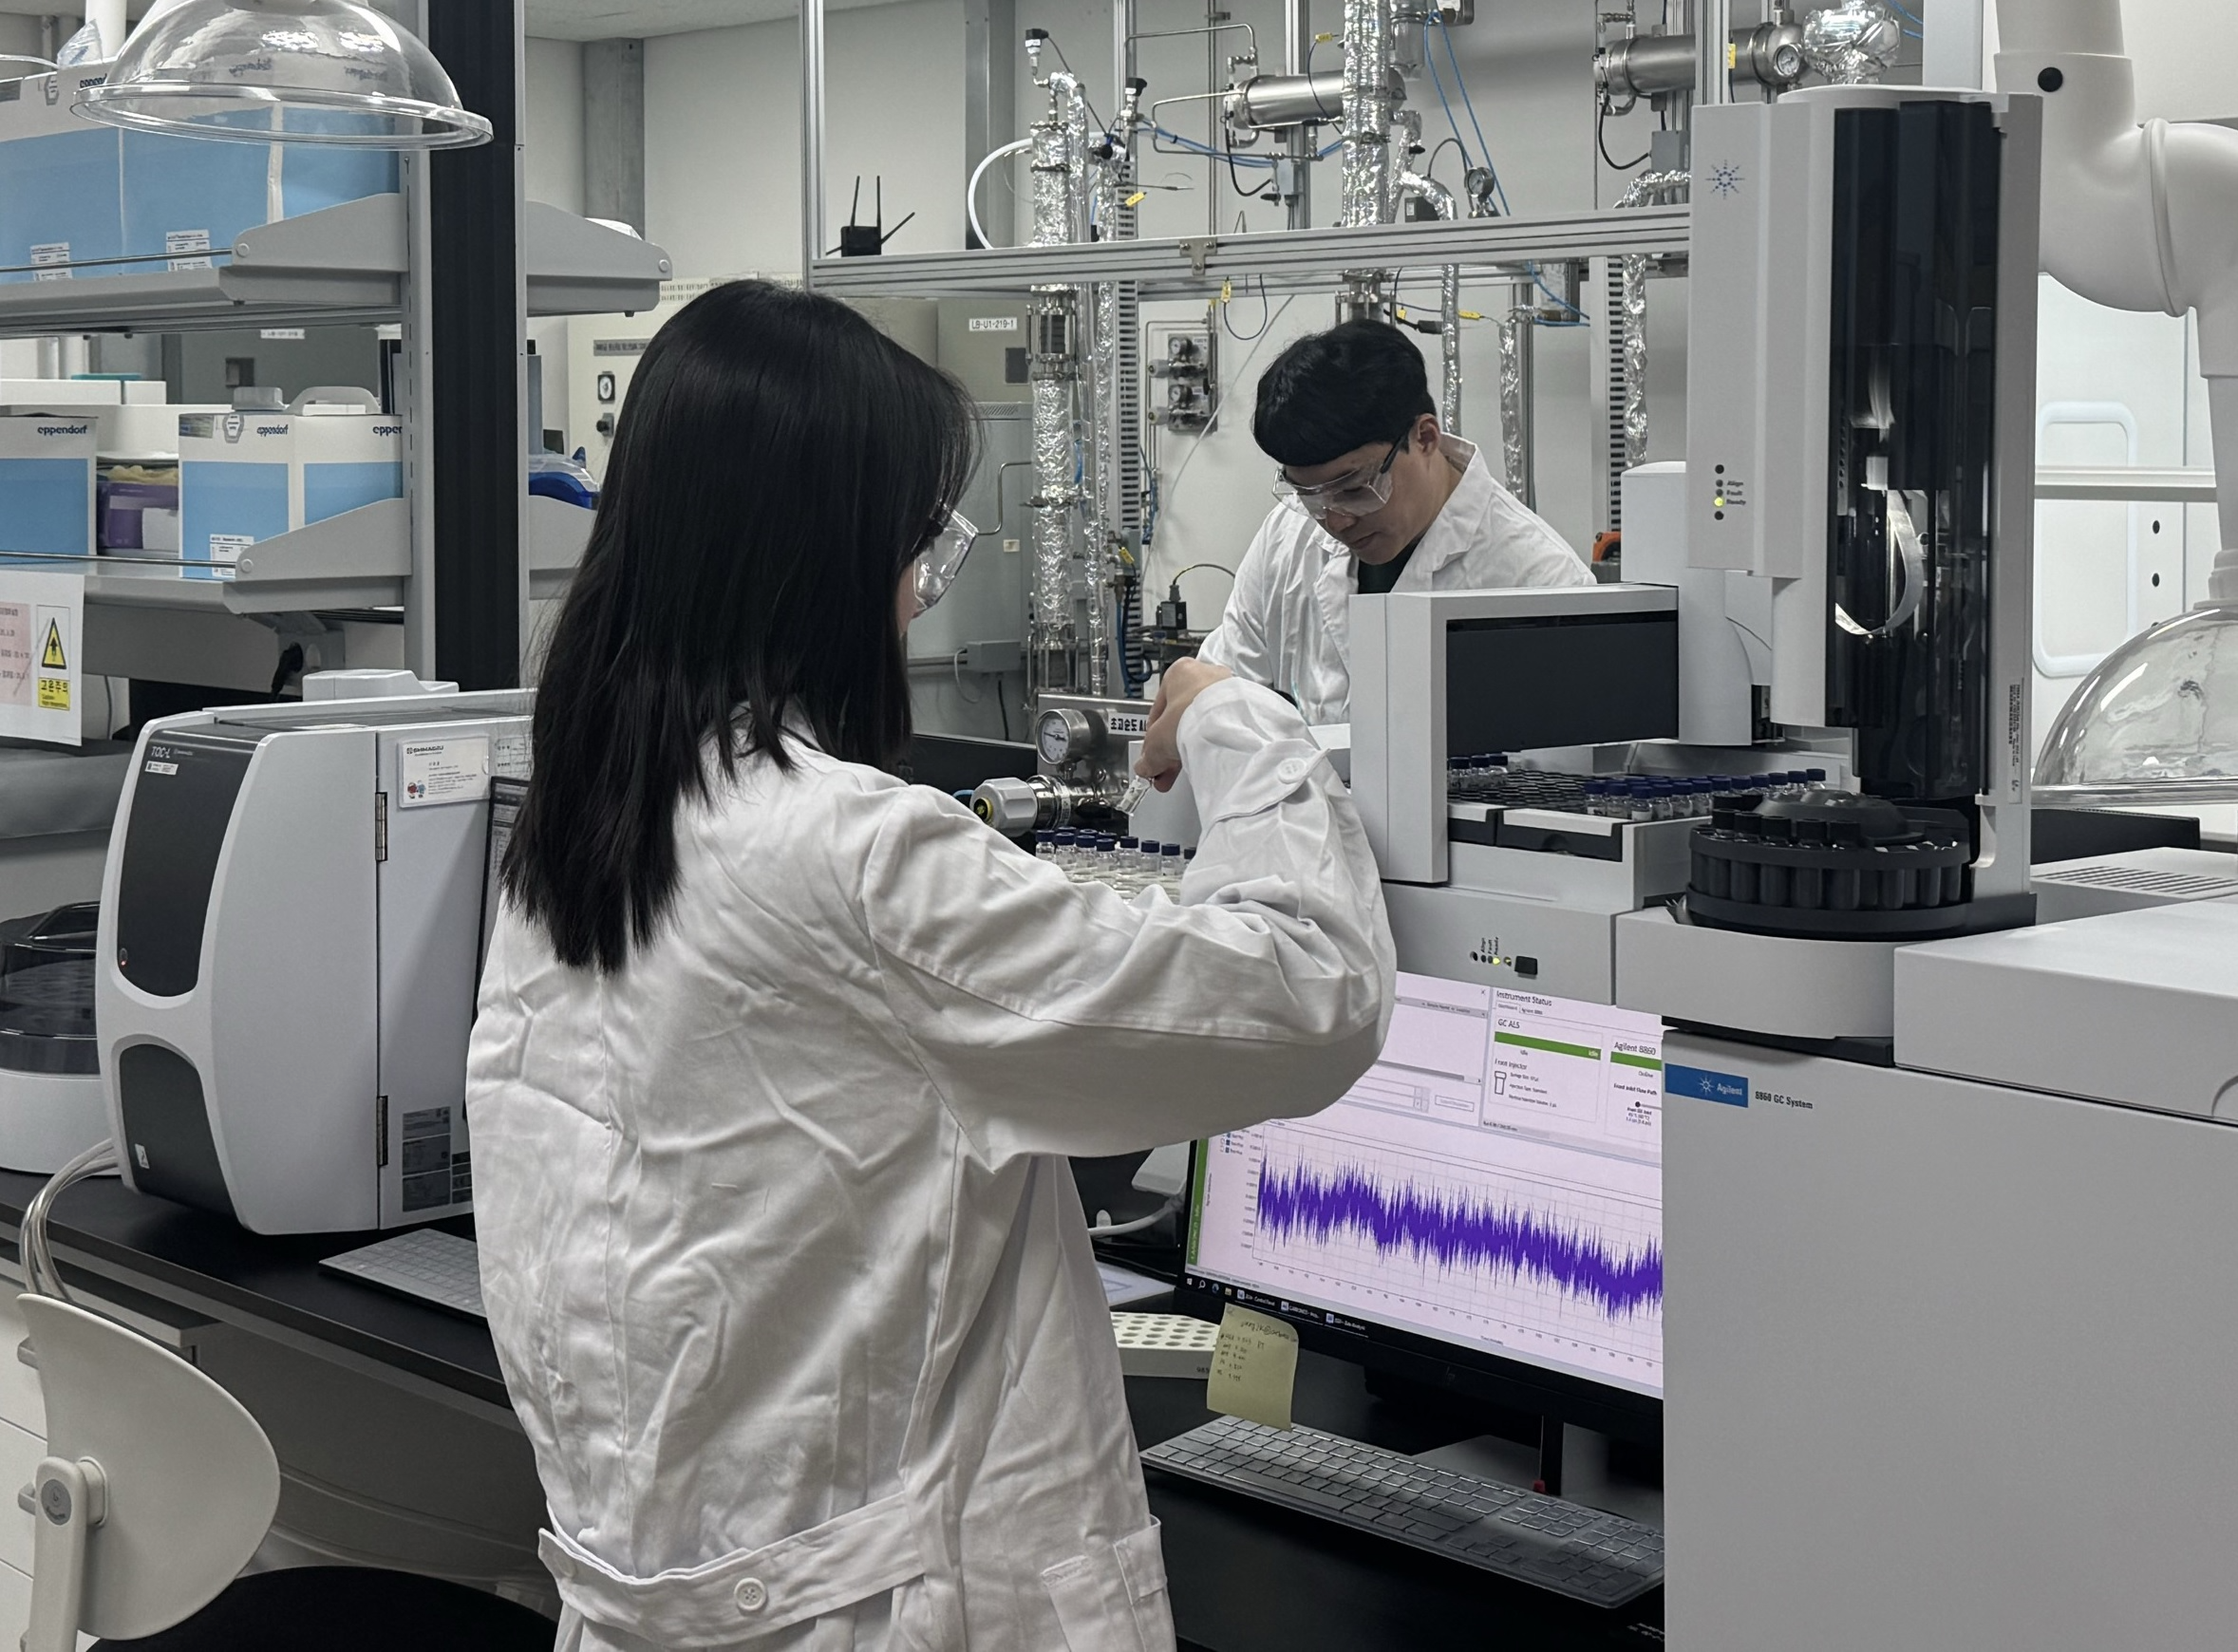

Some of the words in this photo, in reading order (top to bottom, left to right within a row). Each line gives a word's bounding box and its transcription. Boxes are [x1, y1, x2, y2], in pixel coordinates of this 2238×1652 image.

[37, 425, 87, 436] eppendorf
[1614, 1042, 1637, 1052] Agilent
[1717, 1082, 1742, 1096] Agilent
[1773, 1094, 1784, 1104] GC
[1786, 1096, 1814, 1109] System
